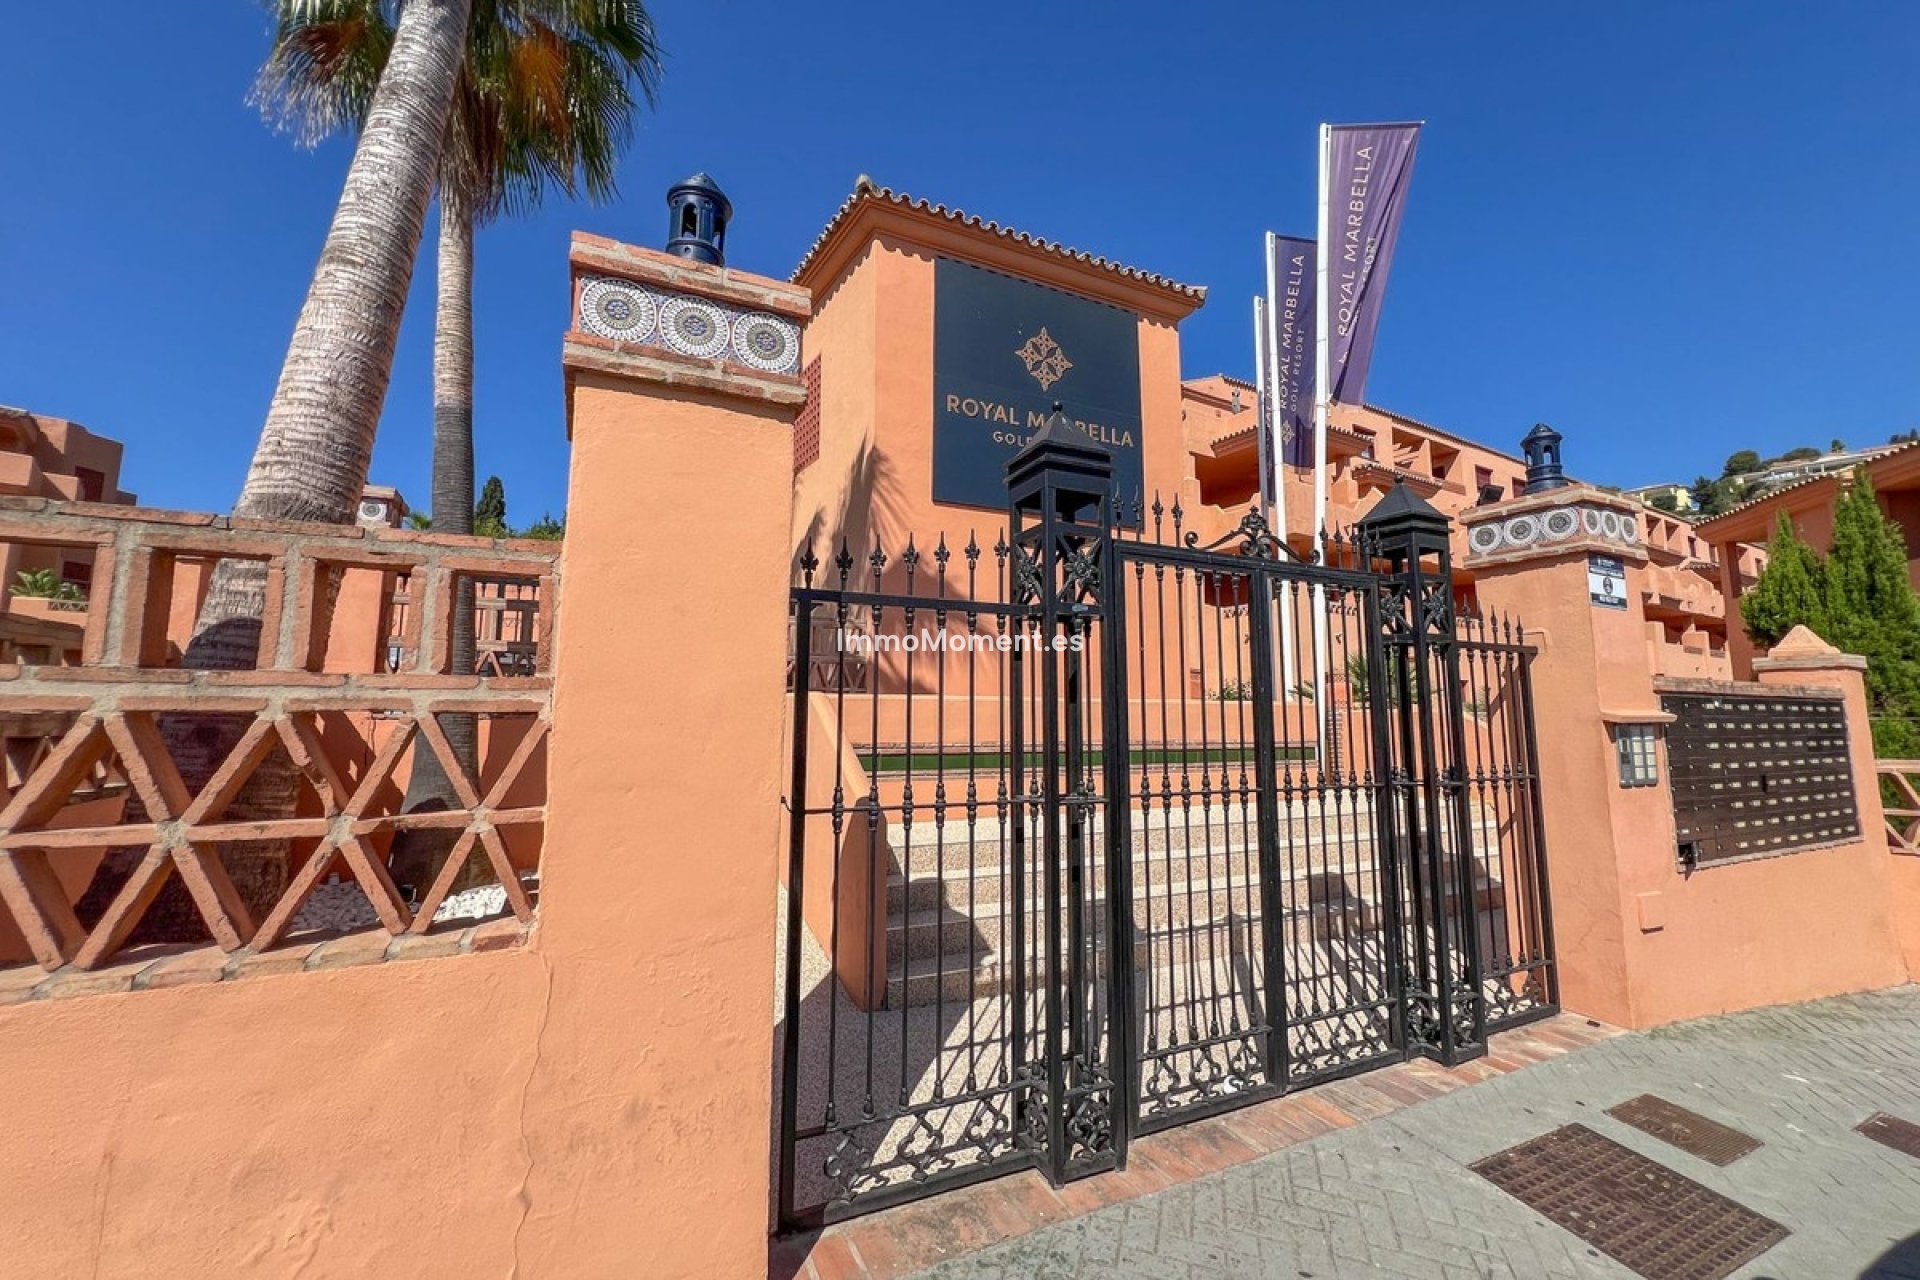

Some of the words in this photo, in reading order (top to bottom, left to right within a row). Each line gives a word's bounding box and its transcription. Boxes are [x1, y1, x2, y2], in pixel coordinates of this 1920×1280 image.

[1343, 146, 1373, 262] MARBELLA
[1282, 255, 1305, 350] MARBELLA
[1338, 270, 1356, 337] ROYAL
[1292, 329, 1305, 375] RESORT
[1280, 354, 1291, 410] ROYAL
[1290, 380, 1299, 412] GOLF
[946, 394, 1020, 425] ROYAL
[1026, 410, 1134, 448] MBELLA
